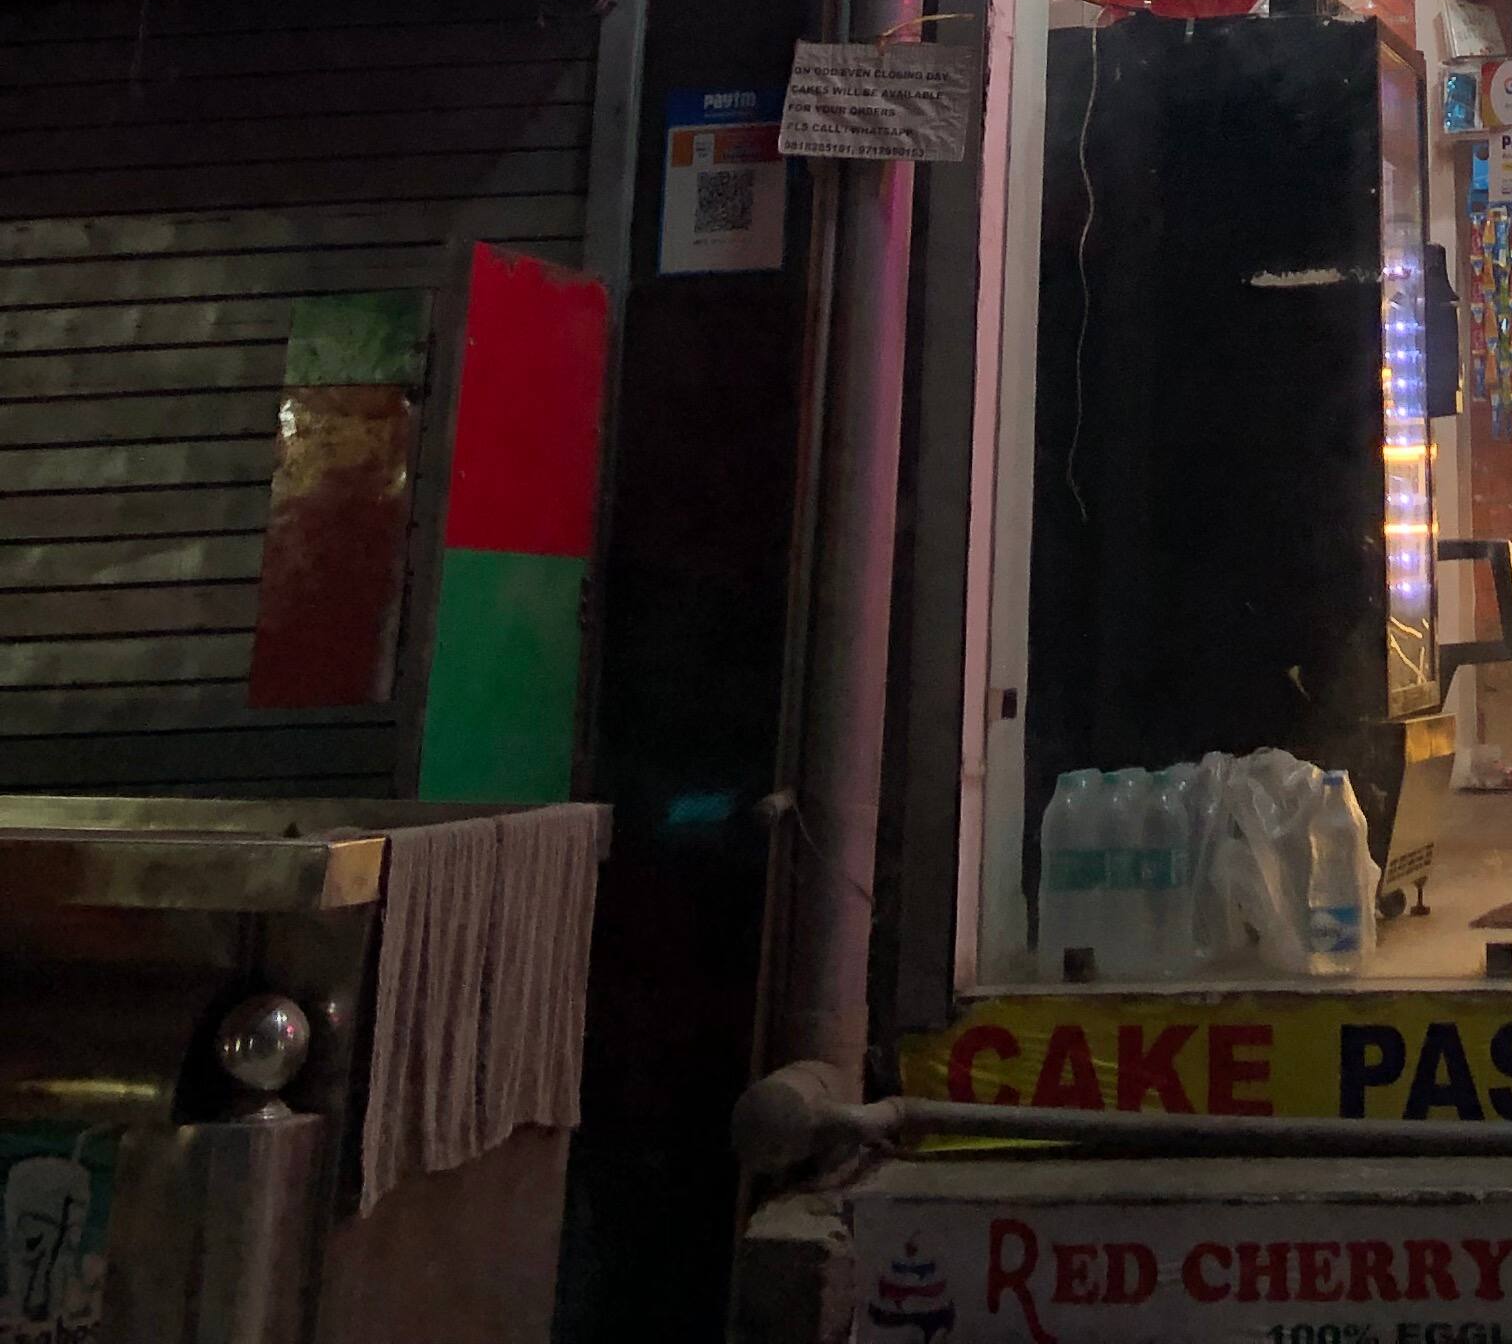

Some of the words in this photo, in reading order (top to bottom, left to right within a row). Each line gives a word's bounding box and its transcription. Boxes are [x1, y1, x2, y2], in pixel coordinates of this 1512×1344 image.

[874, 70, 923, 81] CLOSING
[926, 72, 950, 82] DAY
[791, 84, 829, 95] CAKES
[832, 86, 859, 97] WILL
[880, 89, 944, 100] AVAILABLE
[788, 103, 811, 113] FOR
[815, 105, 848, 115] YOUR
[849, 107, 896, 117] ORDERS
[812, 124, 841, 134] CALL
[850, 126, 914, 137] WHATSAPP
[946, 1023, 1273, 1117] CAKE
[987, 1217, 1160, 1344] RED
